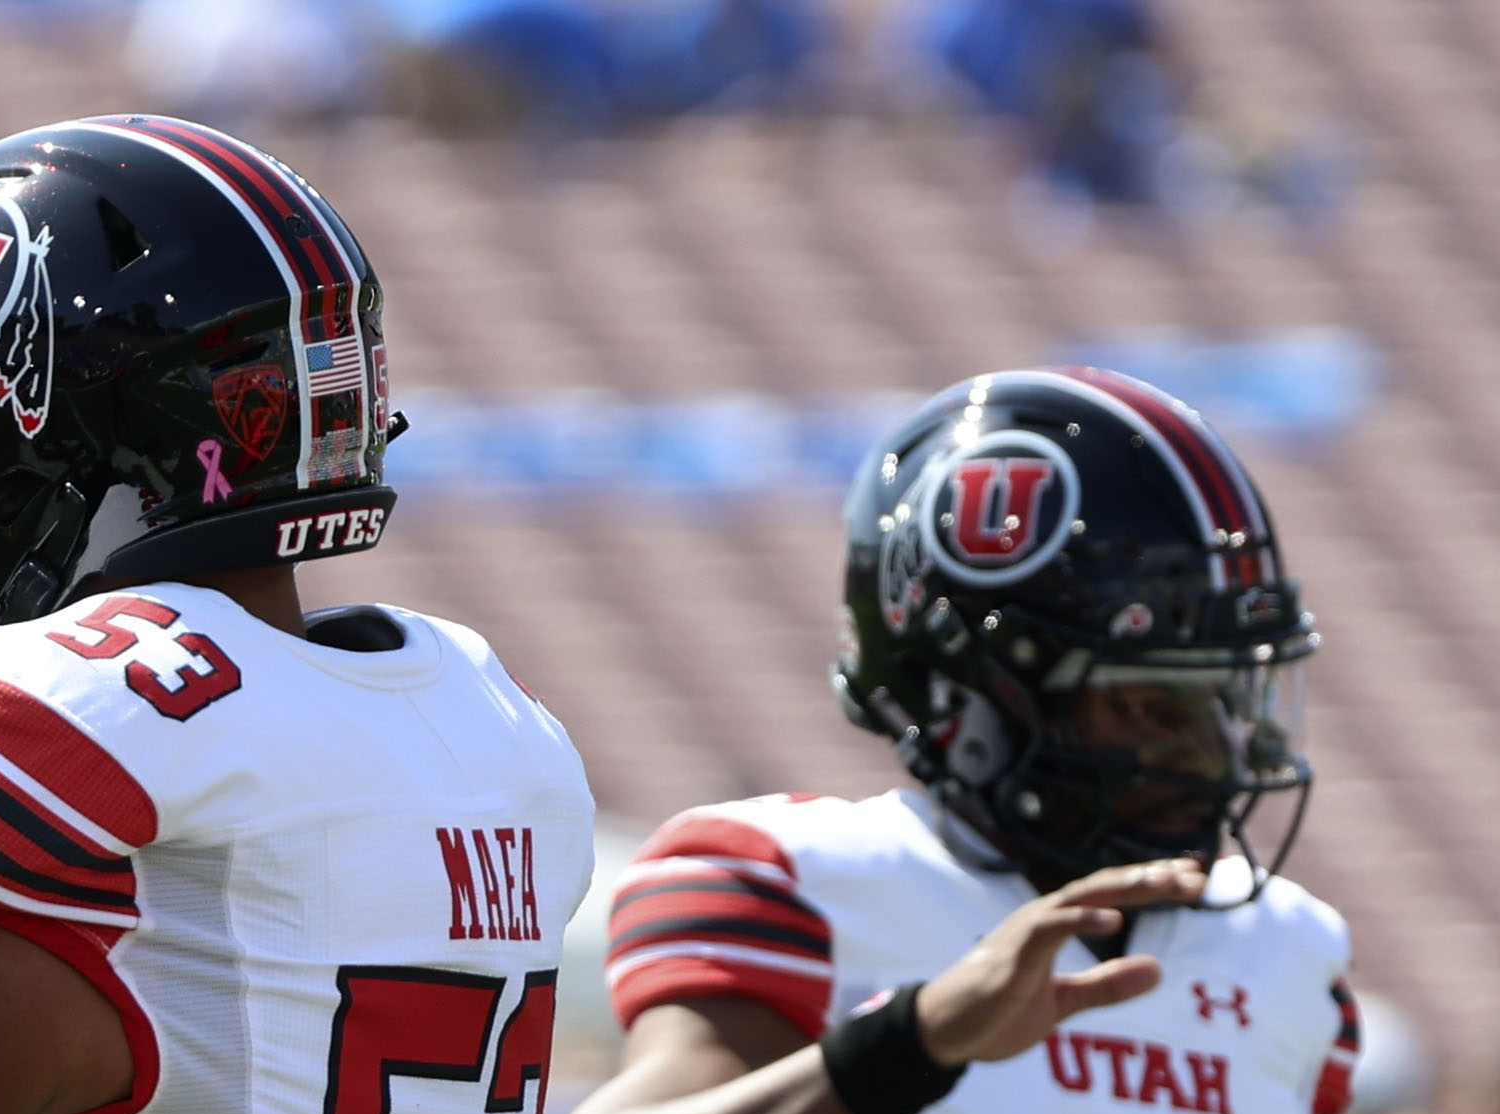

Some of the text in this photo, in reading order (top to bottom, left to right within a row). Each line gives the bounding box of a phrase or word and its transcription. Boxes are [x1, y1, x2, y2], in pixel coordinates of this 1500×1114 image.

[276, 508, 385, 558] UTES
[952, 458, 1056, 562] U
[46, 594, 241, 722] 53
[436, 826, 541, 942] MAEA
